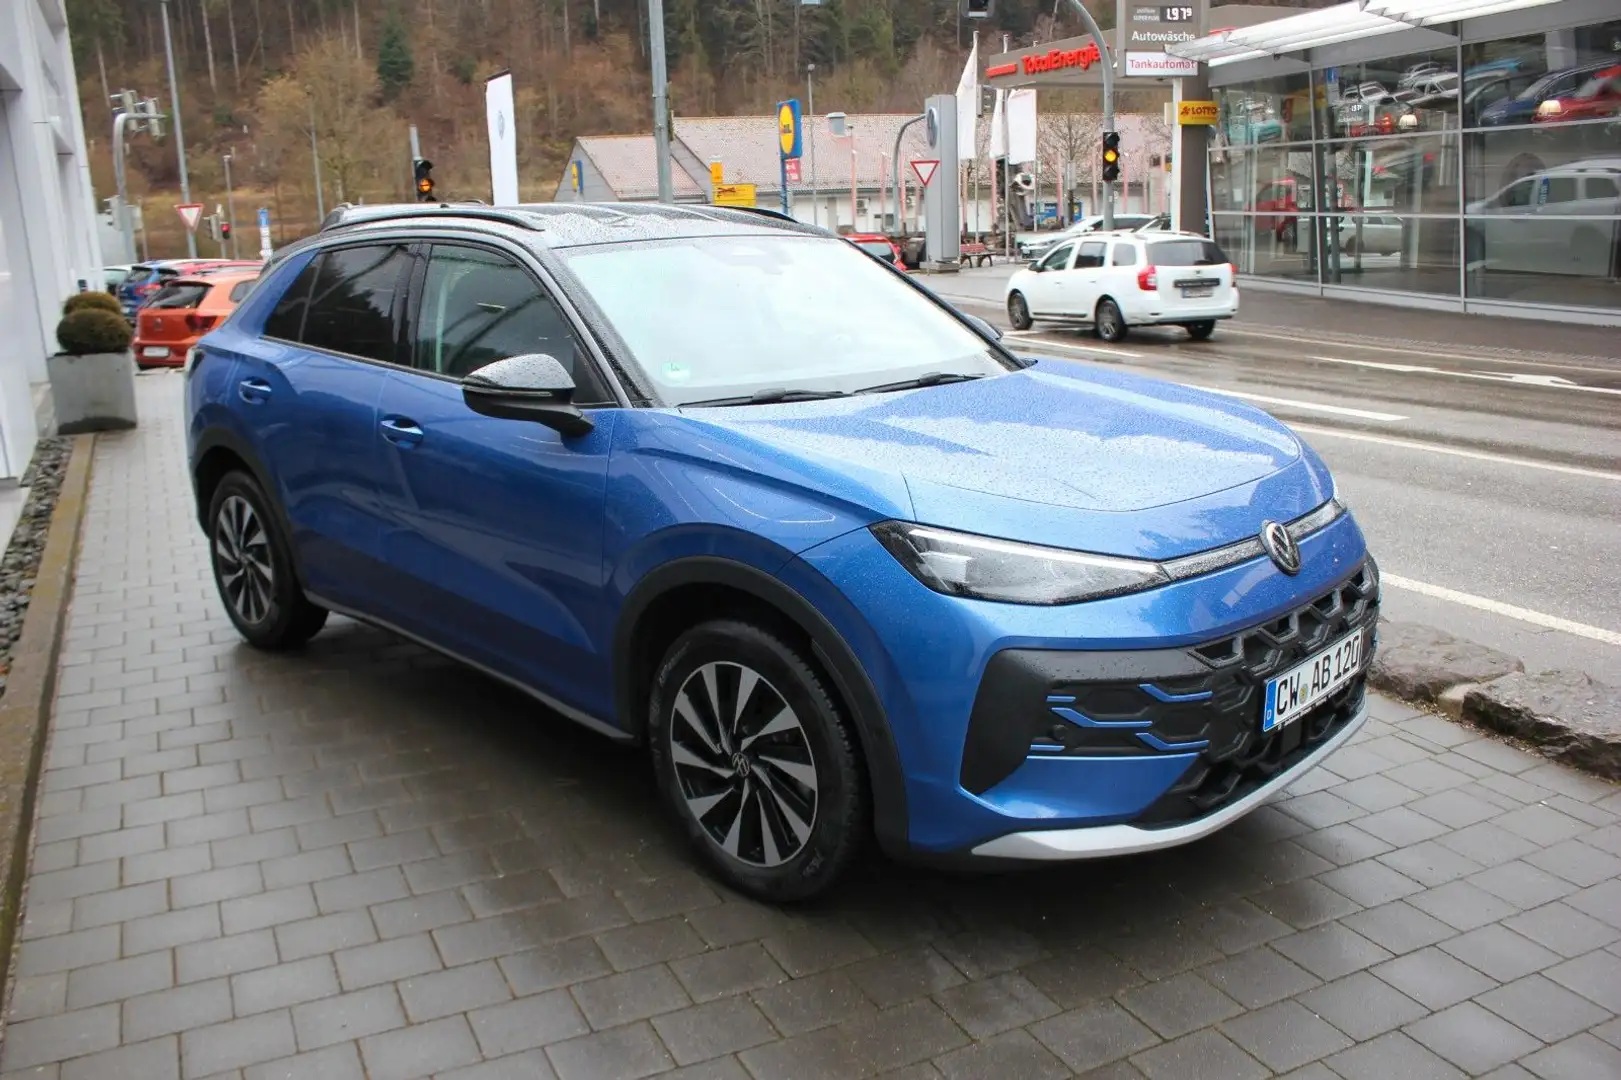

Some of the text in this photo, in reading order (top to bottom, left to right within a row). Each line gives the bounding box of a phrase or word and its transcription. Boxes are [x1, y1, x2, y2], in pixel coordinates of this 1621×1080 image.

[1131, 30, 1196, 42] Autowäsche
[1021, 41, 1106, 75] TotalEnergie
[1129, 59, 1196, 70] Tankautomat
[1191, 106, 1217, 115] LOTTO
[1276, 671, 1301, 715] CW
[1310, 654, 1331, 697] AB
[1334, 635, 1360, 681] 120
